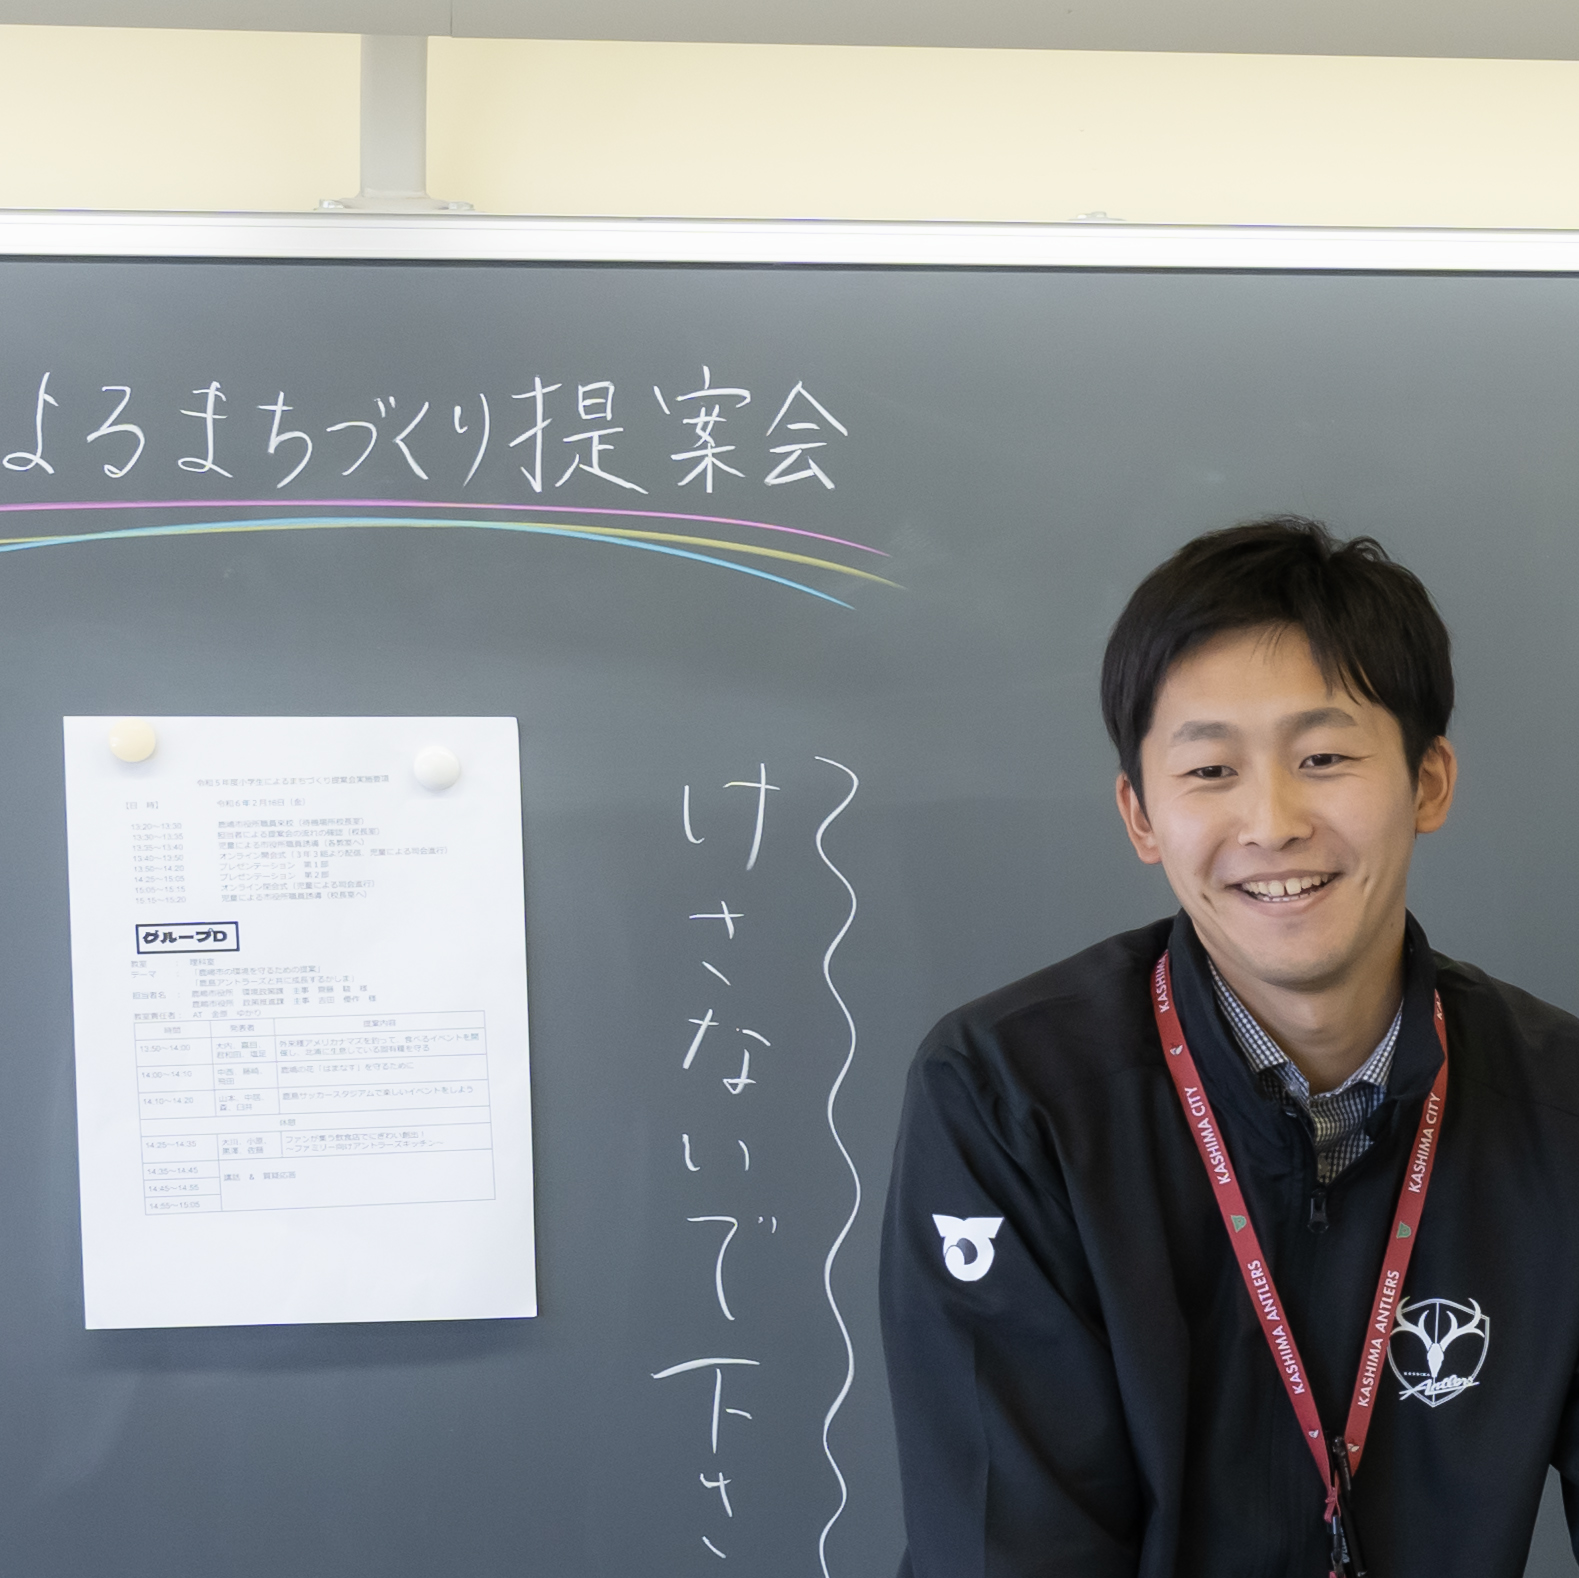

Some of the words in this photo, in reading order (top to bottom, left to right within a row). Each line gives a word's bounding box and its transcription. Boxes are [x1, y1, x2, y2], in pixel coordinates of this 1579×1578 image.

[1, 366, 848, 494] よるまちづくり提案会
[143, 927, 228, 944] グループD
[1184, 1086, 1207, 1117] CITY
[1198, 1117, 1232, 1185] KASHIMA
[1407, 1128, 1434, 1193] KASHIMA
[1425, 1092, 1441, 1125] CITY
[1247, 1260, 1281, 1321] ANTLERS
[1272, 1325, 1306, 1395] KASHIMA
[1358, 1338, 1383, 1407] KASHIMA
[1375, 1270, 1400, 1334] ANTLERS
